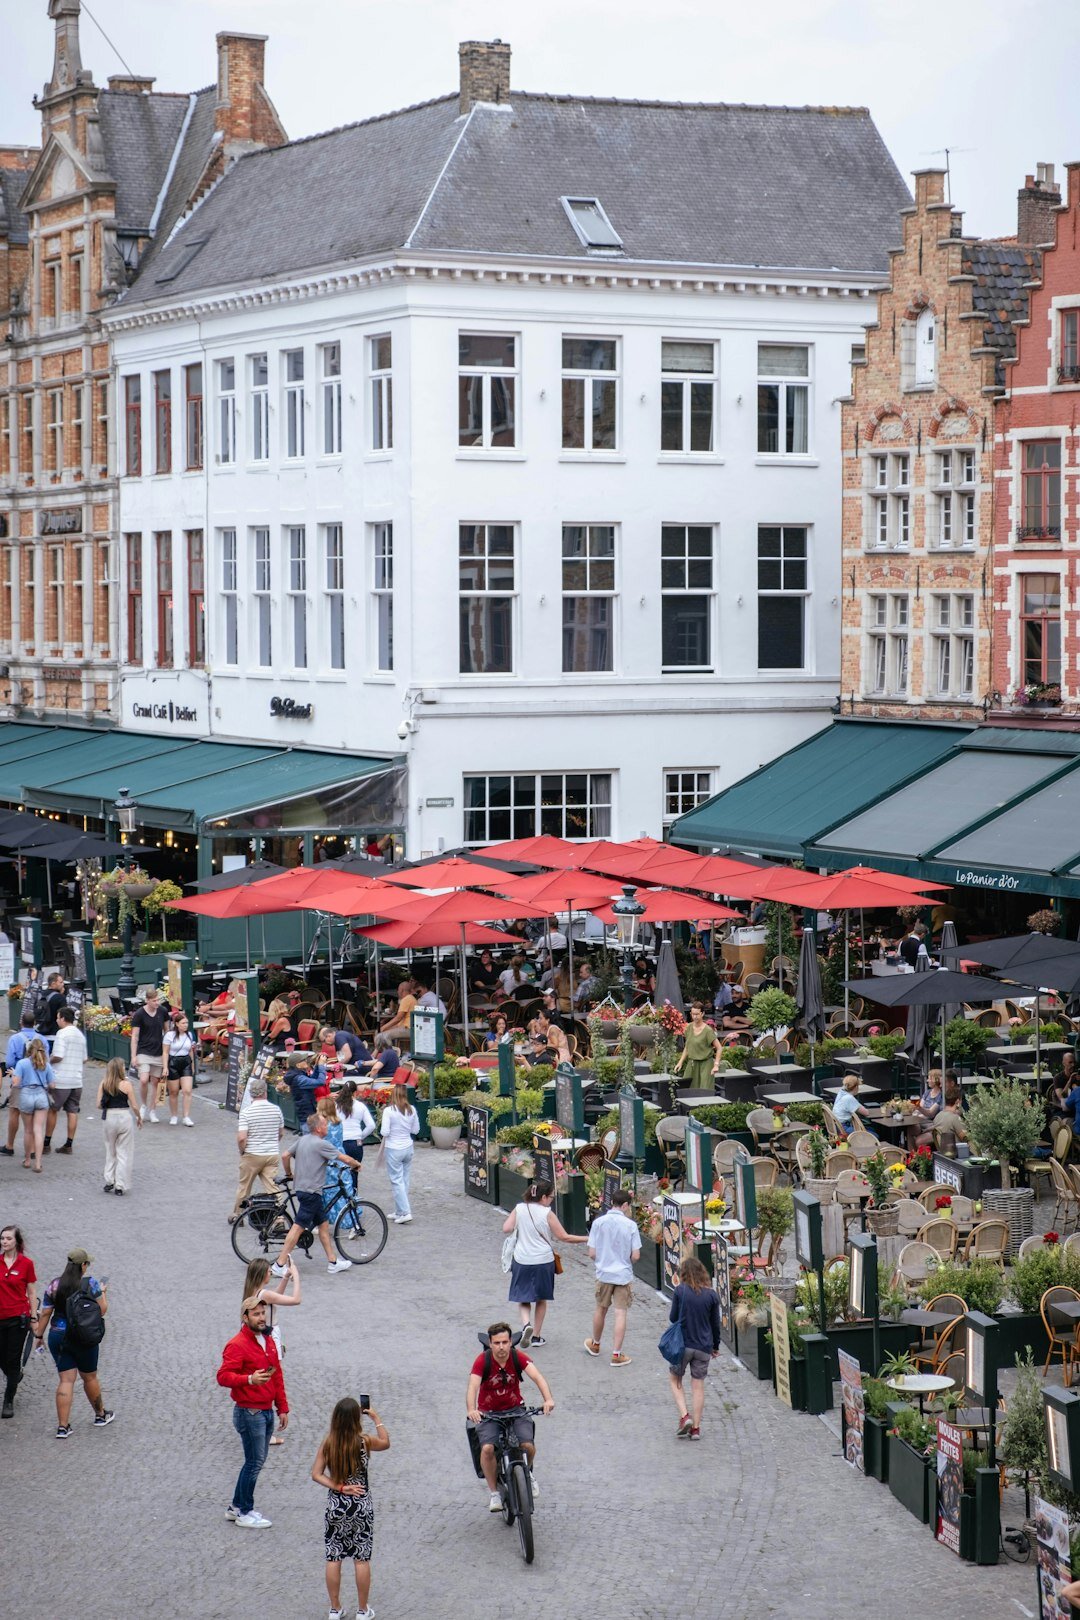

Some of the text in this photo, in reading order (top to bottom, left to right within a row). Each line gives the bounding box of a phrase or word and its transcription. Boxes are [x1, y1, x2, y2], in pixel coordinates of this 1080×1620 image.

[132, 702, 197, 722] Grand Café Belfort
[998, 874, 1019, 889] d'Or
[934, 1164, 961, 1195] BEER
[664, 1204, 678, 1221] PIZZA
[938, 1420, 961, 1445] MOULES
[940, 1437, 960, 1460] FRITES
